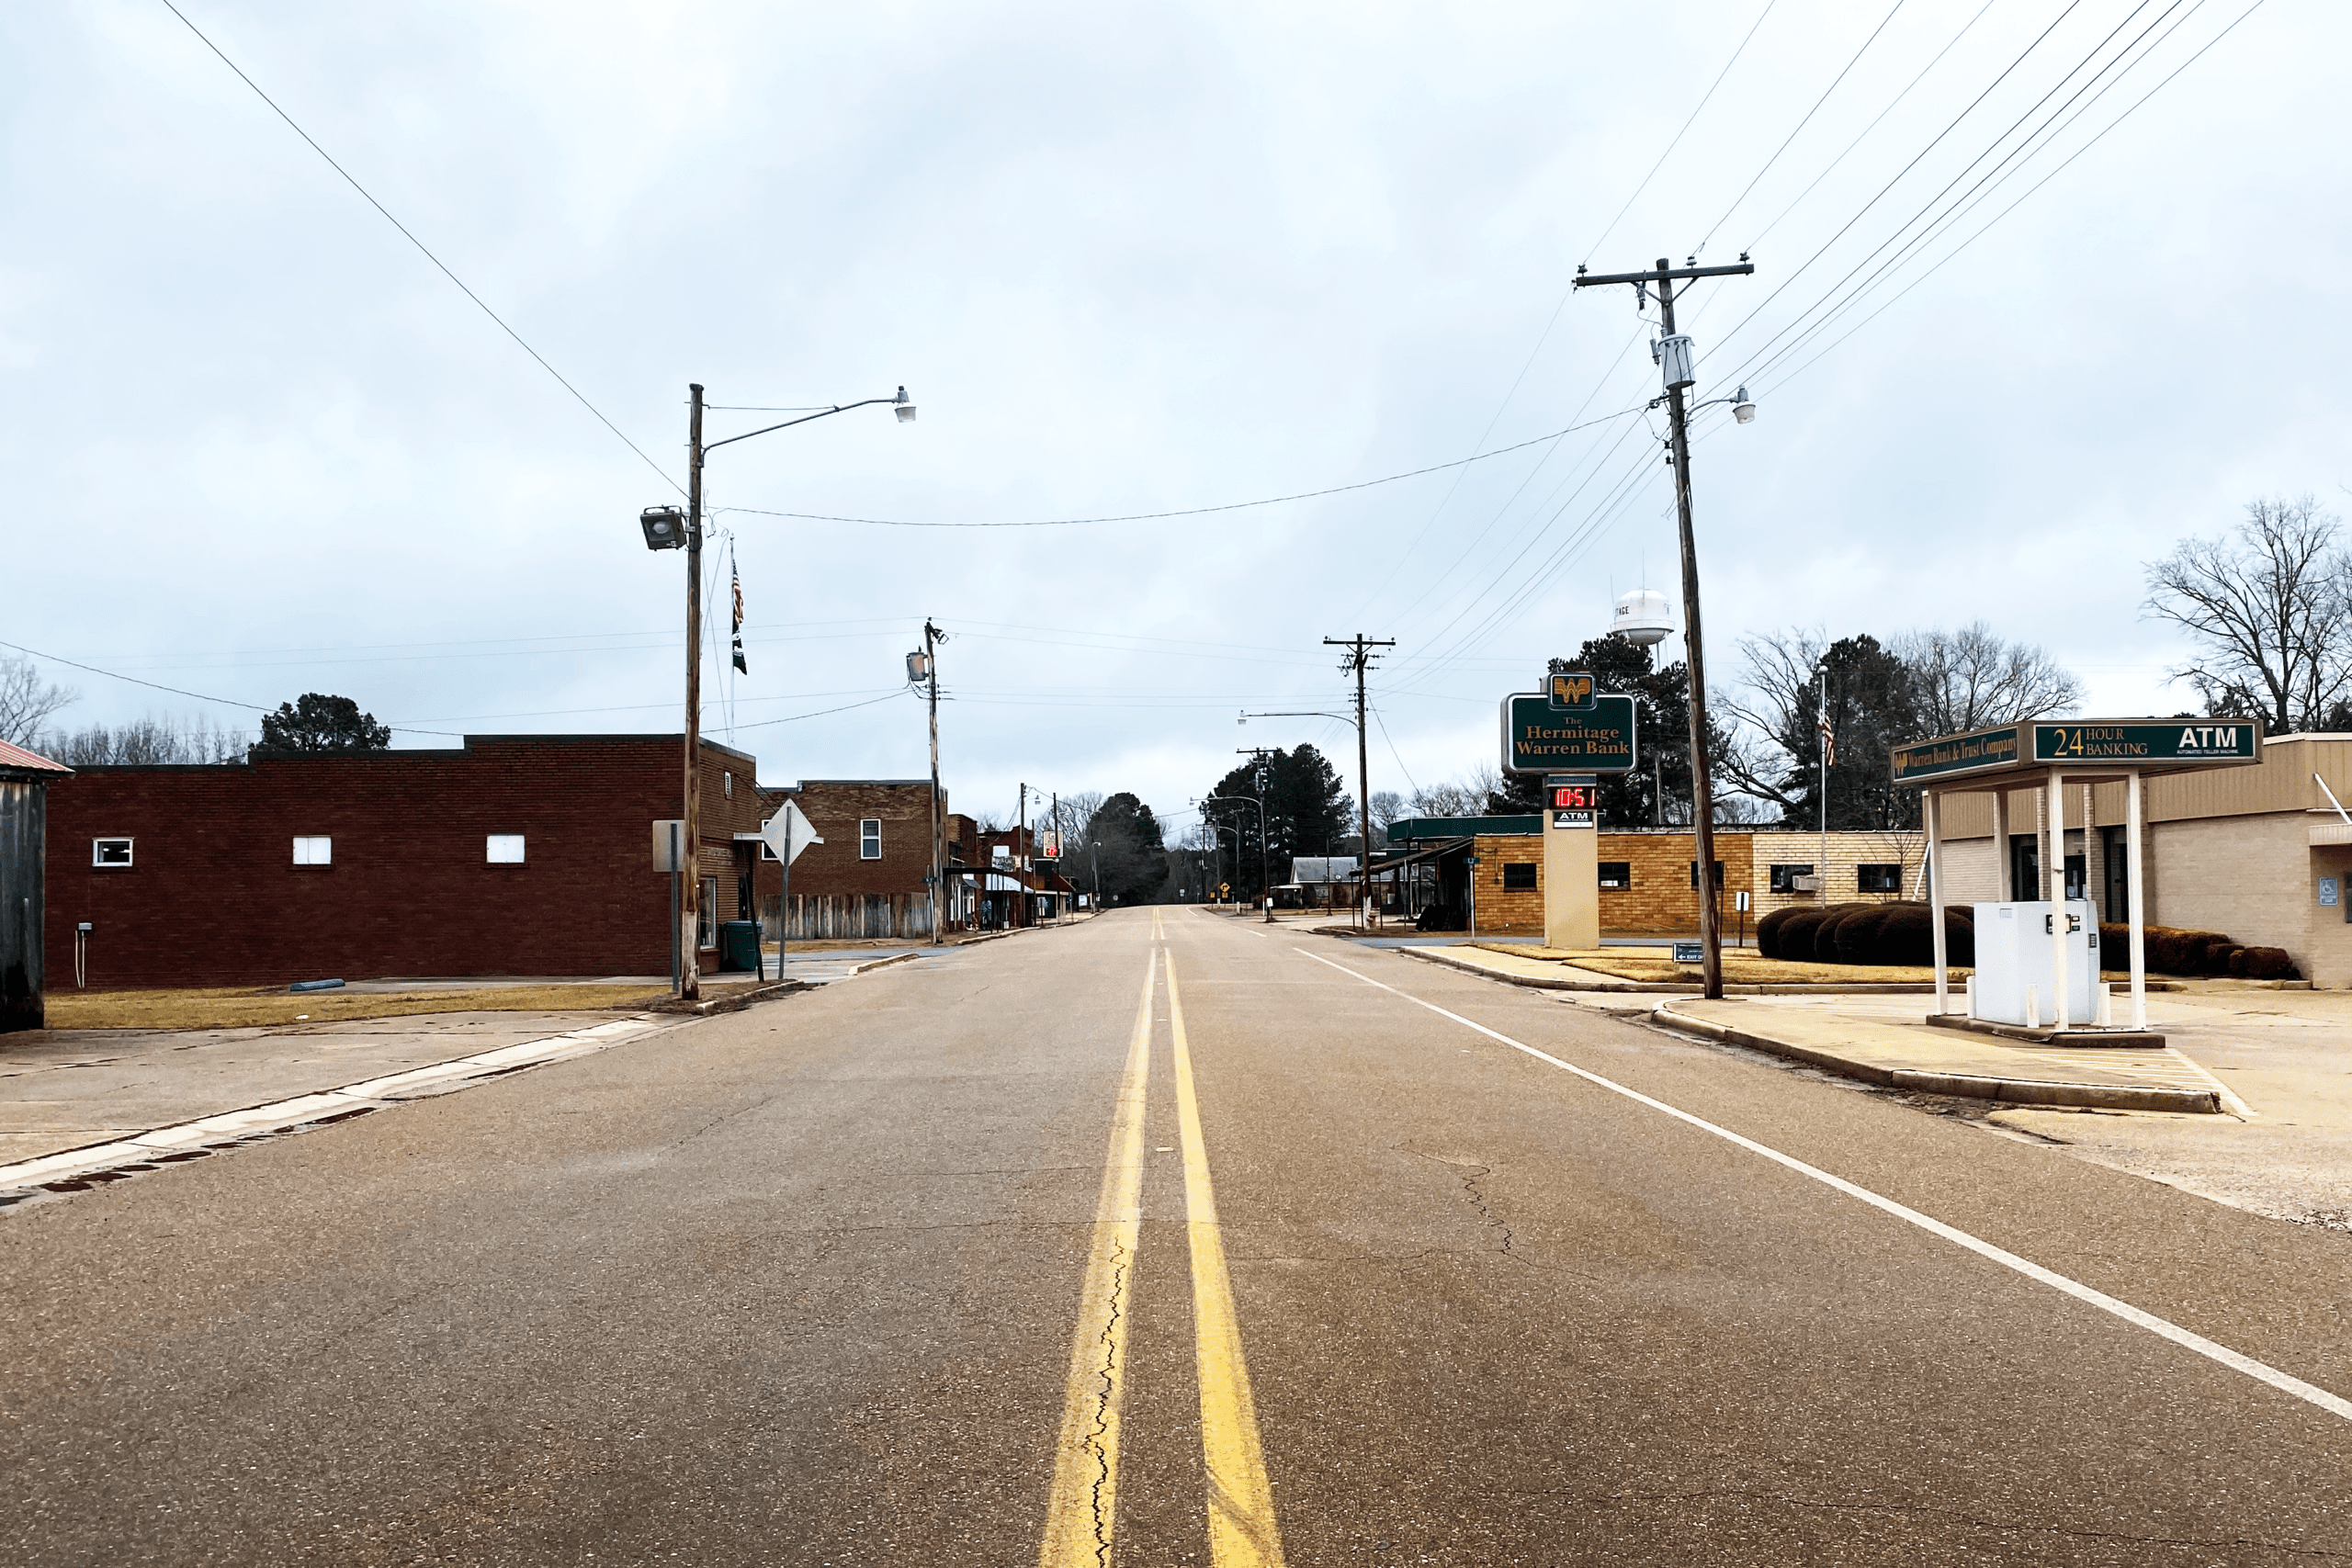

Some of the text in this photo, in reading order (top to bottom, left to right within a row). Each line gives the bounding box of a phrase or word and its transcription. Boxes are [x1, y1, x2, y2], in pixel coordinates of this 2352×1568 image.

[1564, 716, 1582, 725] The
[1526, 725, 1620, 743] Hermitage
[2053, 728, 2125, 756] 24 HOUR
[2178, 727, 2236, 748] ATM
[1516, 740, 1630, 755] Warren Bank
[1907, 738, 2017, 767] Warren Bank & Trust Company
[2086, 742, 2148, 756] BANKING
